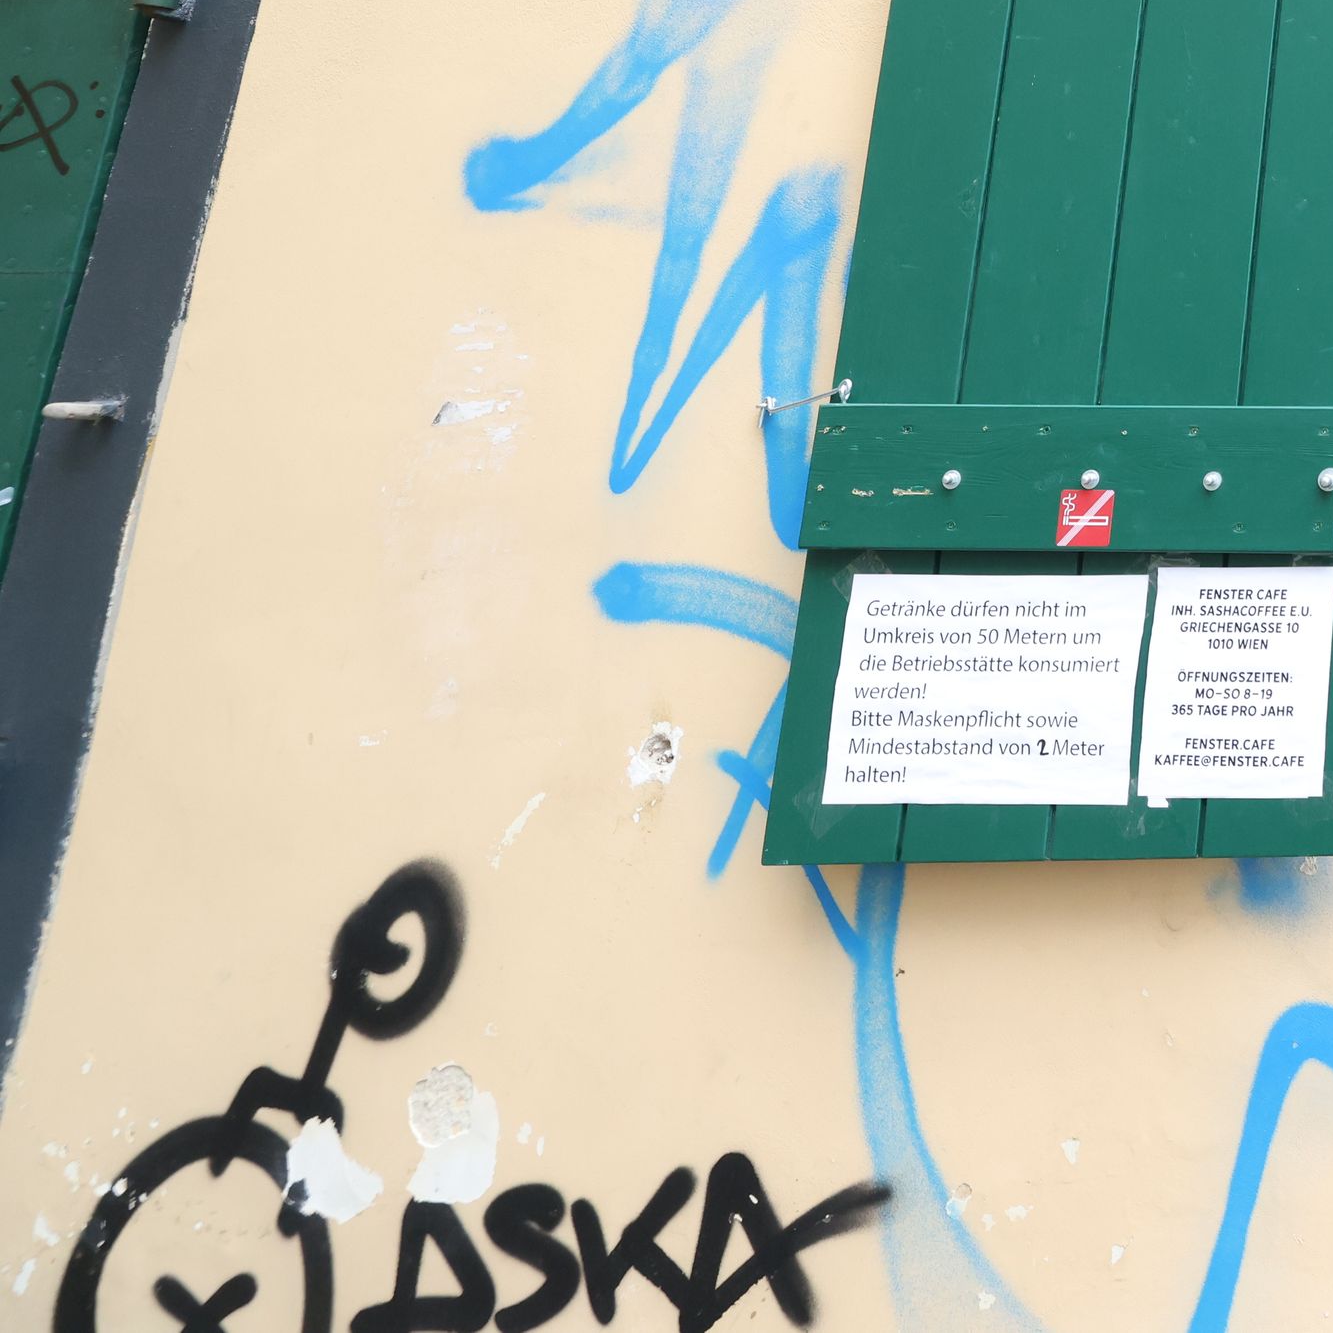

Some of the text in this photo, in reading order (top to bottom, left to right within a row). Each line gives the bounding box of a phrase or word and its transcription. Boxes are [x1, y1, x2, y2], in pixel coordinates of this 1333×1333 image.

[1199, 588, 1287, 600] FENSTER CAFE
[866, 599, 1086, 618] Getränke dürfen nicht im
[1171, 605, 1312, 618] INH. SASHACOFFEE E.U.
[1180, 622, 1299, 634] GRIECHENGASSE 10
[864, 628, 1101, 646] Umkreis von 50 Metern um
[1208, 638, 1268, 651] 1010 WIEN
[859, 654, 1120, 674] die Betriebsstätte konsumiert
[1177, 670, 1293, 683] ÖFFNUNGSZEITEN:
[854, 682, 927, 700] werden!
[1171, 704, 1294, 717] 365 TAGE PRO JAHR
[852, 710, 1078, 731] Bitte Maskenpflicht sowie
[848, 738, 1104, 757] Mindestabstand von 2 Meter
[1185, 738, 1276, 750] FENSTER.CAFE
[1154, 755, 1304, 768] KAFFEE@FENSTER.CAFE
[845, 765, 906, 784] halten!
